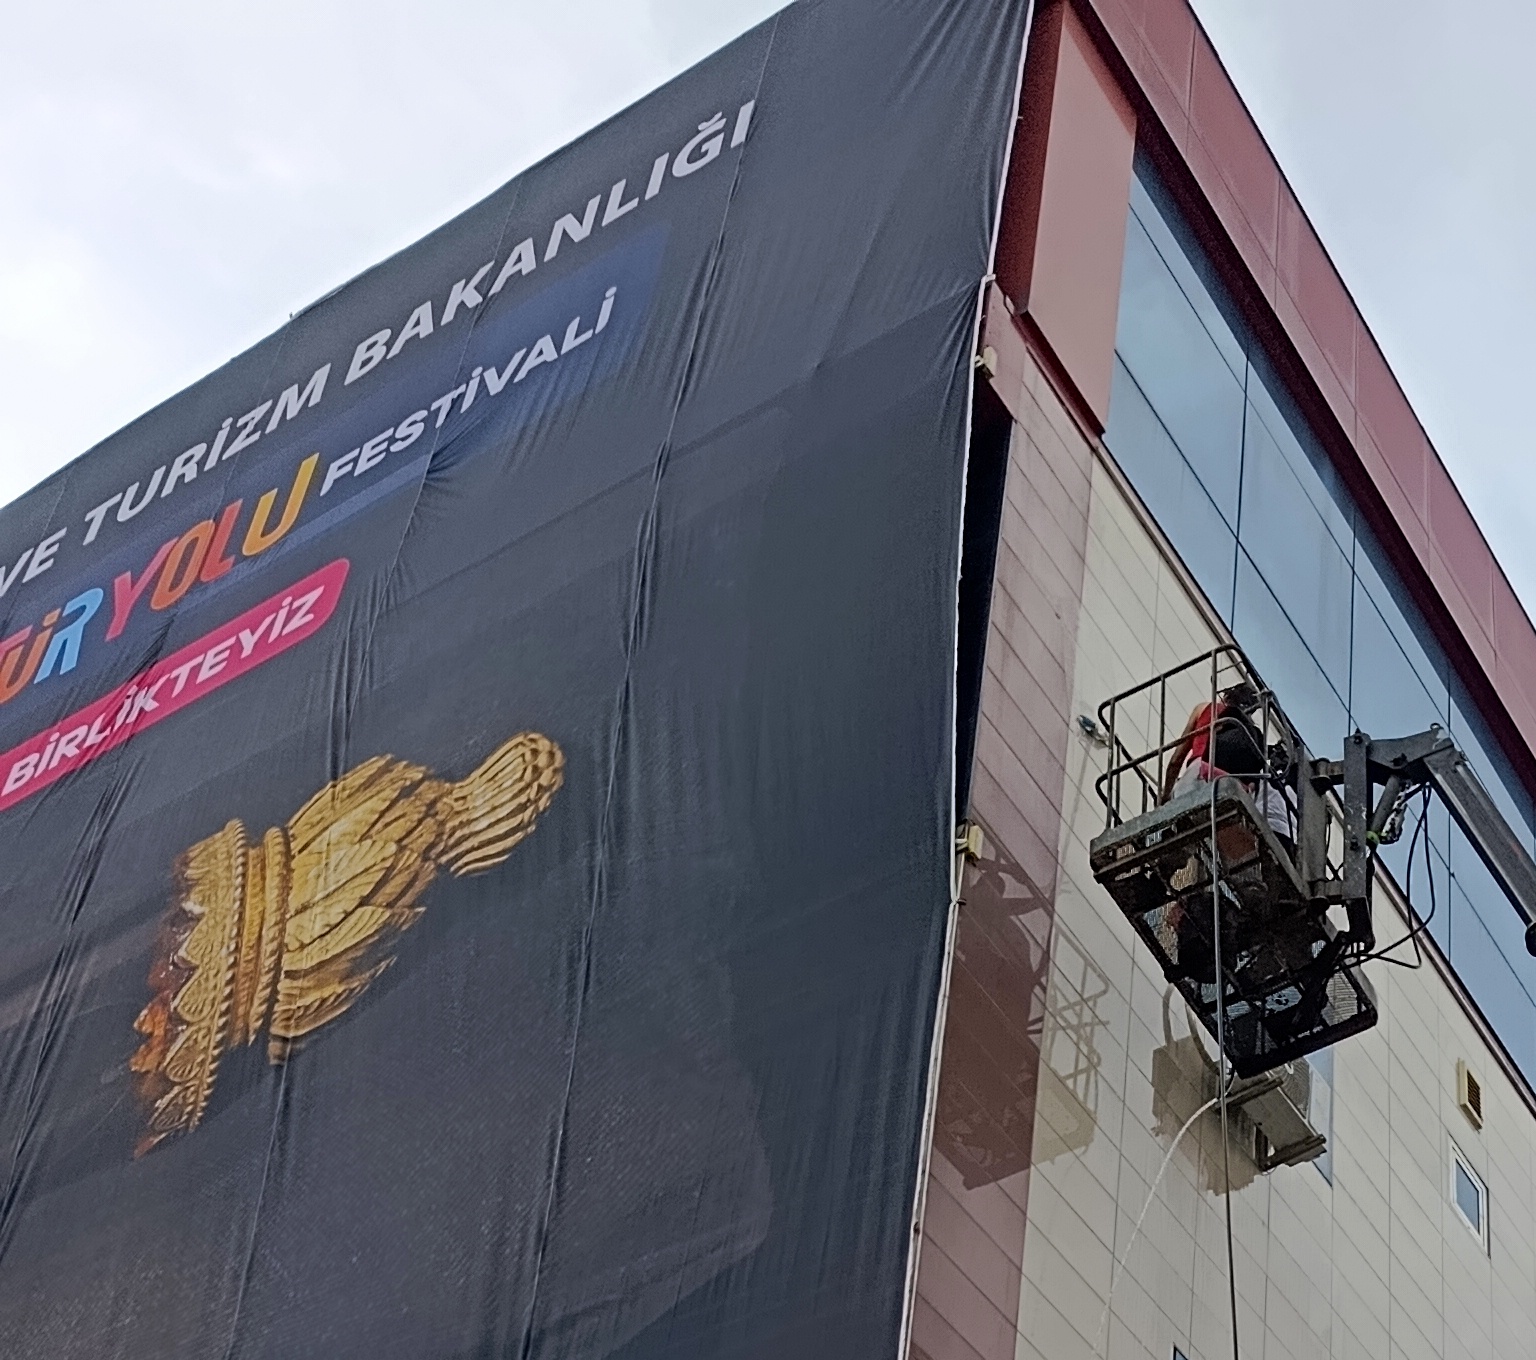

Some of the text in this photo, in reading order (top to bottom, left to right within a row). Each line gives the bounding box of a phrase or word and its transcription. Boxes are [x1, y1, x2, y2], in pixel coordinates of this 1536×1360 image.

[83, 362, 332, 546] TURİZM
[343, 100, 756, 386] BAKANLIĞI
[105, 452, 320, 642] YOLU
[319, 286, 618, 497] FESTİVALİ
[0, 585, 326, 797] BİRLİKTEYİZ
